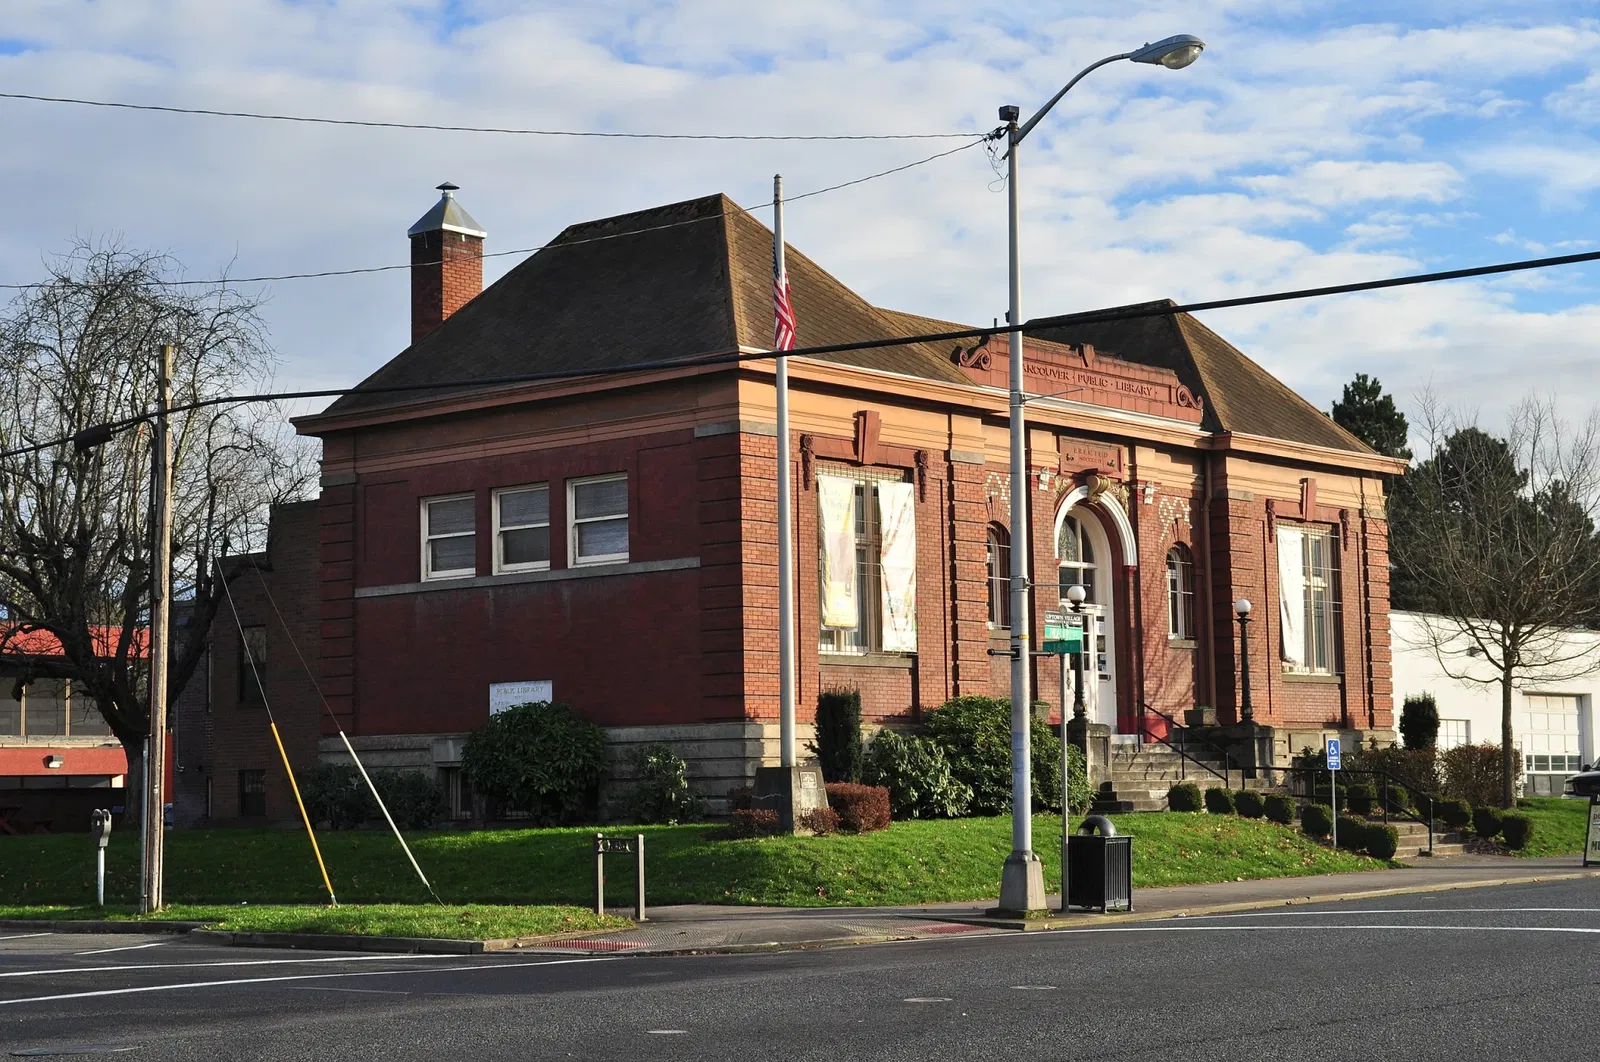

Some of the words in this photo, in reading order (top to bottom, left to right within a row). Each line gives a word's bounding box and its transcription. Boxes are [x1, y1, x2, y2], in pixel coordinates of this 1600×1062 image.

[1023, 363, 1070, 381] ANCOUVER
[1077, 373, 1108, 388] PUBLIC
[1115, 380, 1153, 396] LIBRARY
[1073, 447, 1109, 458] ERECTED
[517, 685, 544, 694] LIBRARY
